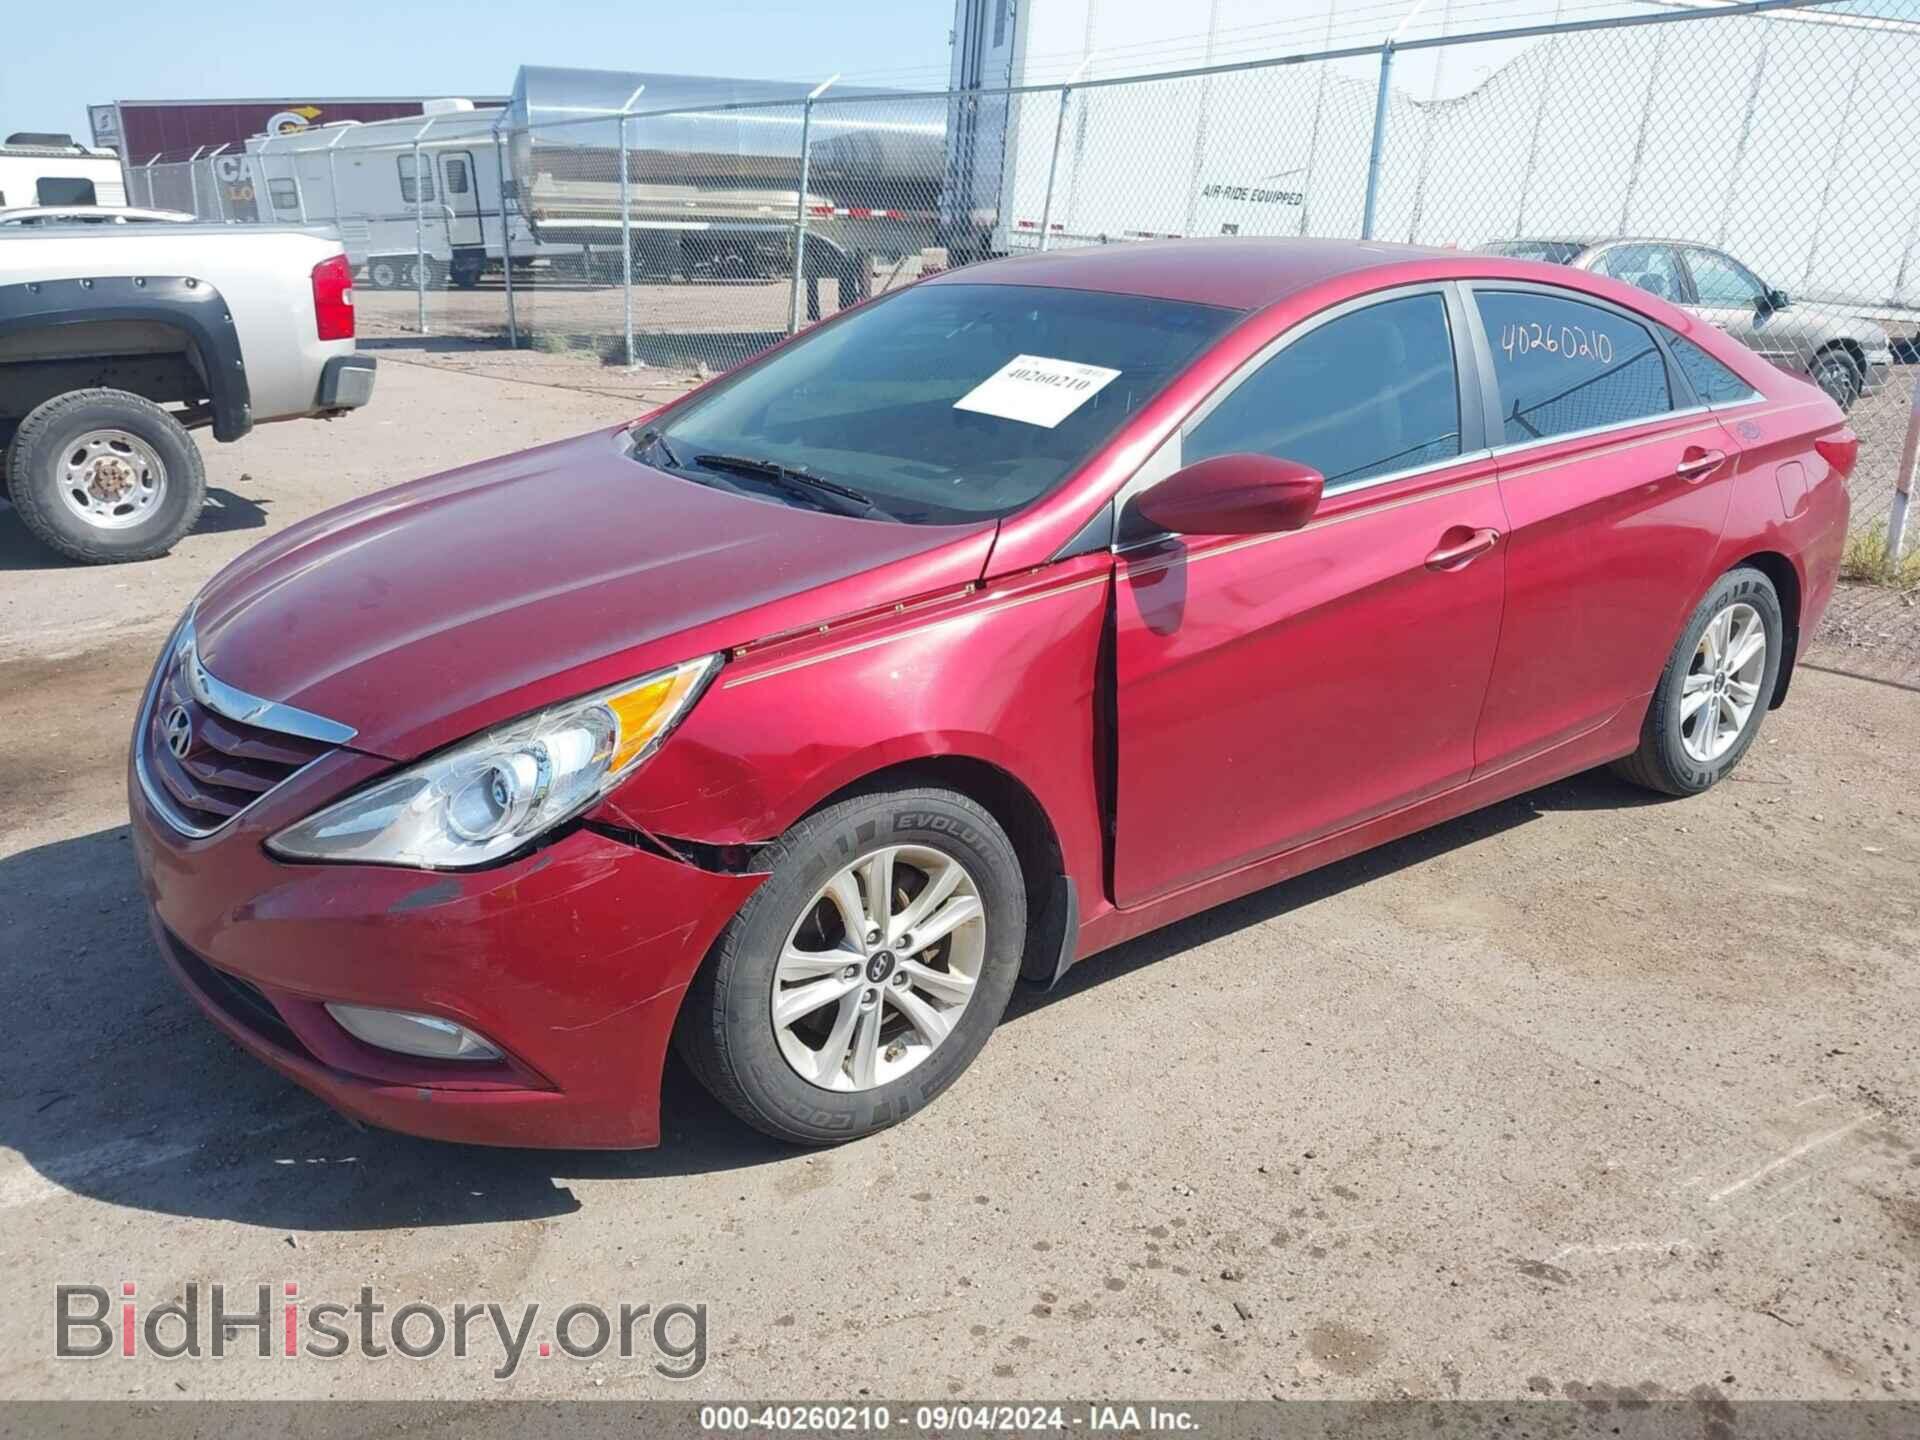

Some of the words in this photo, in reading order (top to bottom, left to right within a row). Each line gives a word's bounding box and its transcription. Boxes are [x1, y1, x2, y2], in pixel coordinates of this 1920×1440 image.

[1202, 183, 1249, 201] AIR-RIDE
[1250, 188, 1304, 206] EQUIPPED
[1502, 323, 1612, 363] 40260210
[1008, 368, 1090, 391] 40260210
